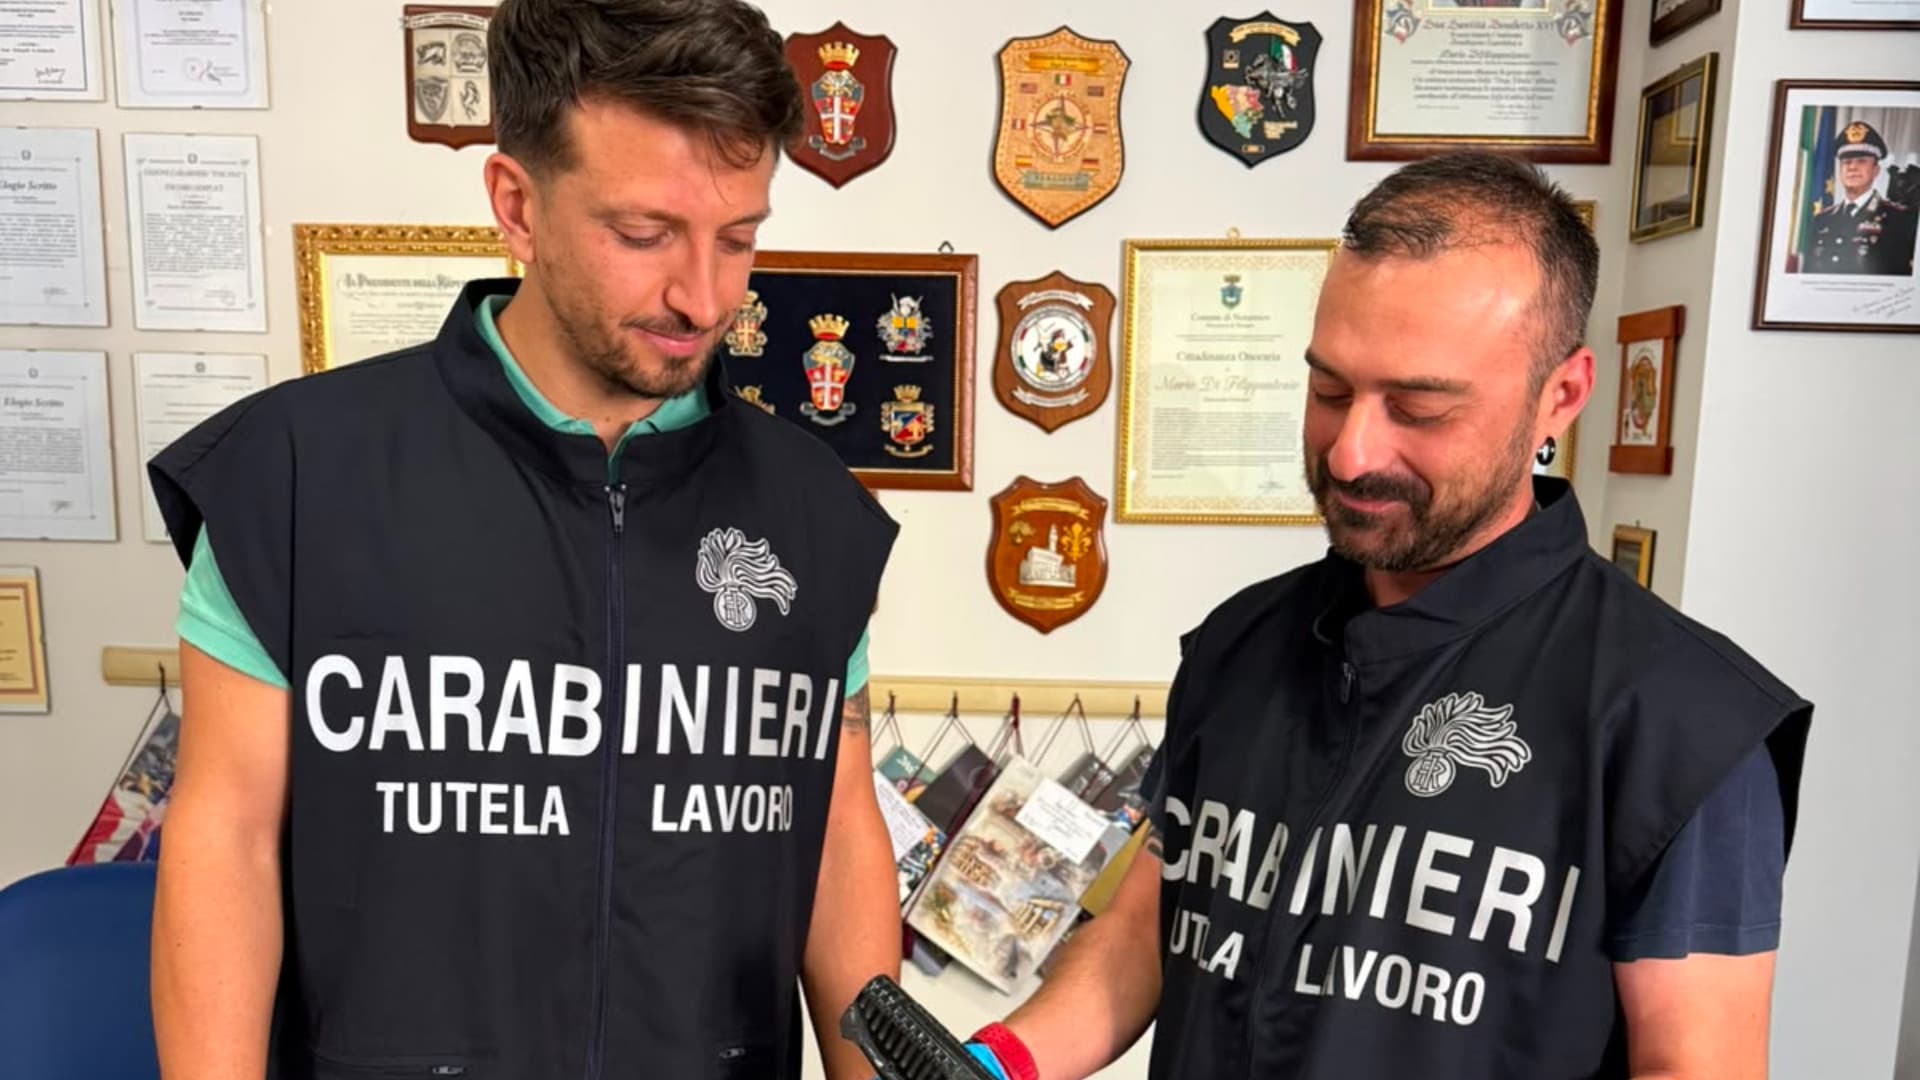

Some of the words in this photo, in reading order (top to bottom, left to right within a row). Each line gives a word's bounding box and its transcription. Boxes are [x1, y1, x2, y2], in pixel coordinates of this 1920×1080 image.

[305, 653, 840, 761] CARABINIERI
[376, 781, 570, 836] TUTELA
[652, 783, 793, 833] LAVORO
